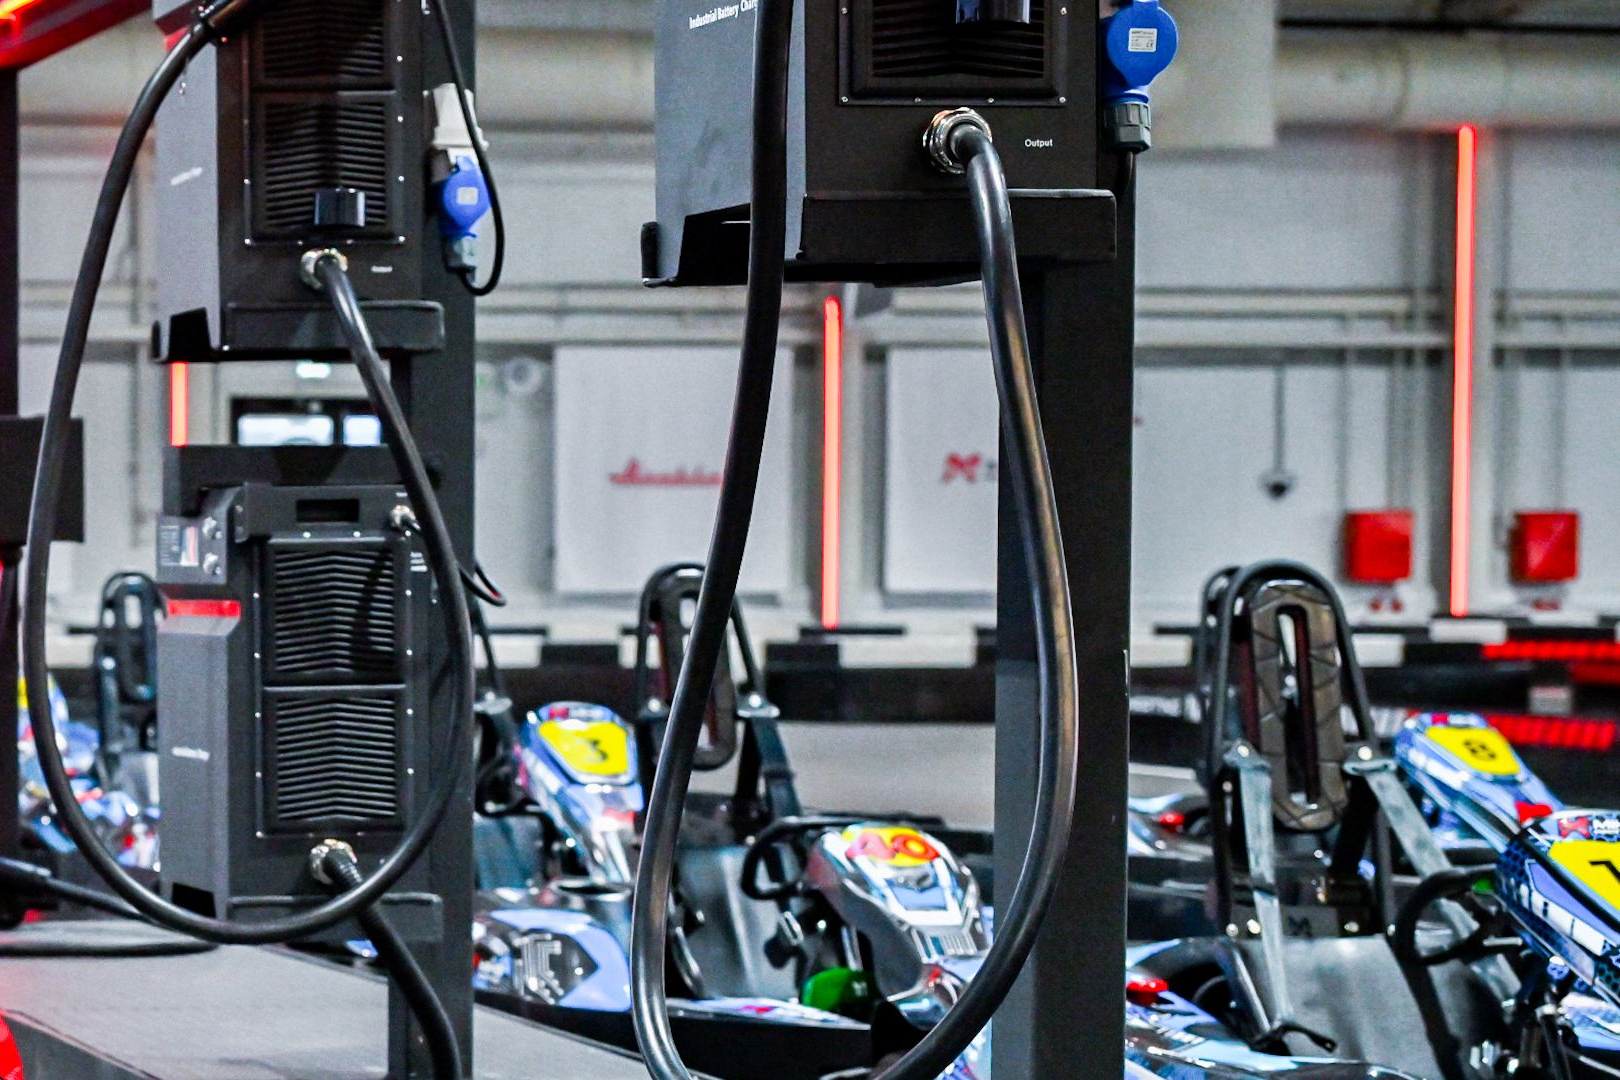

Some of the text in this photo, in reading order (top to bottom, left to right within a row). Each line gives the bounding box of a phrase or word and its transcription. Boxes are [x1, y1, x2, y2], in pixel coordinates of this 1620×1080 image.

[689, 8, 717, 29] Industrial
[717, 4, 740, 20] Battery
[1024, 138, 1053, 149] Output
